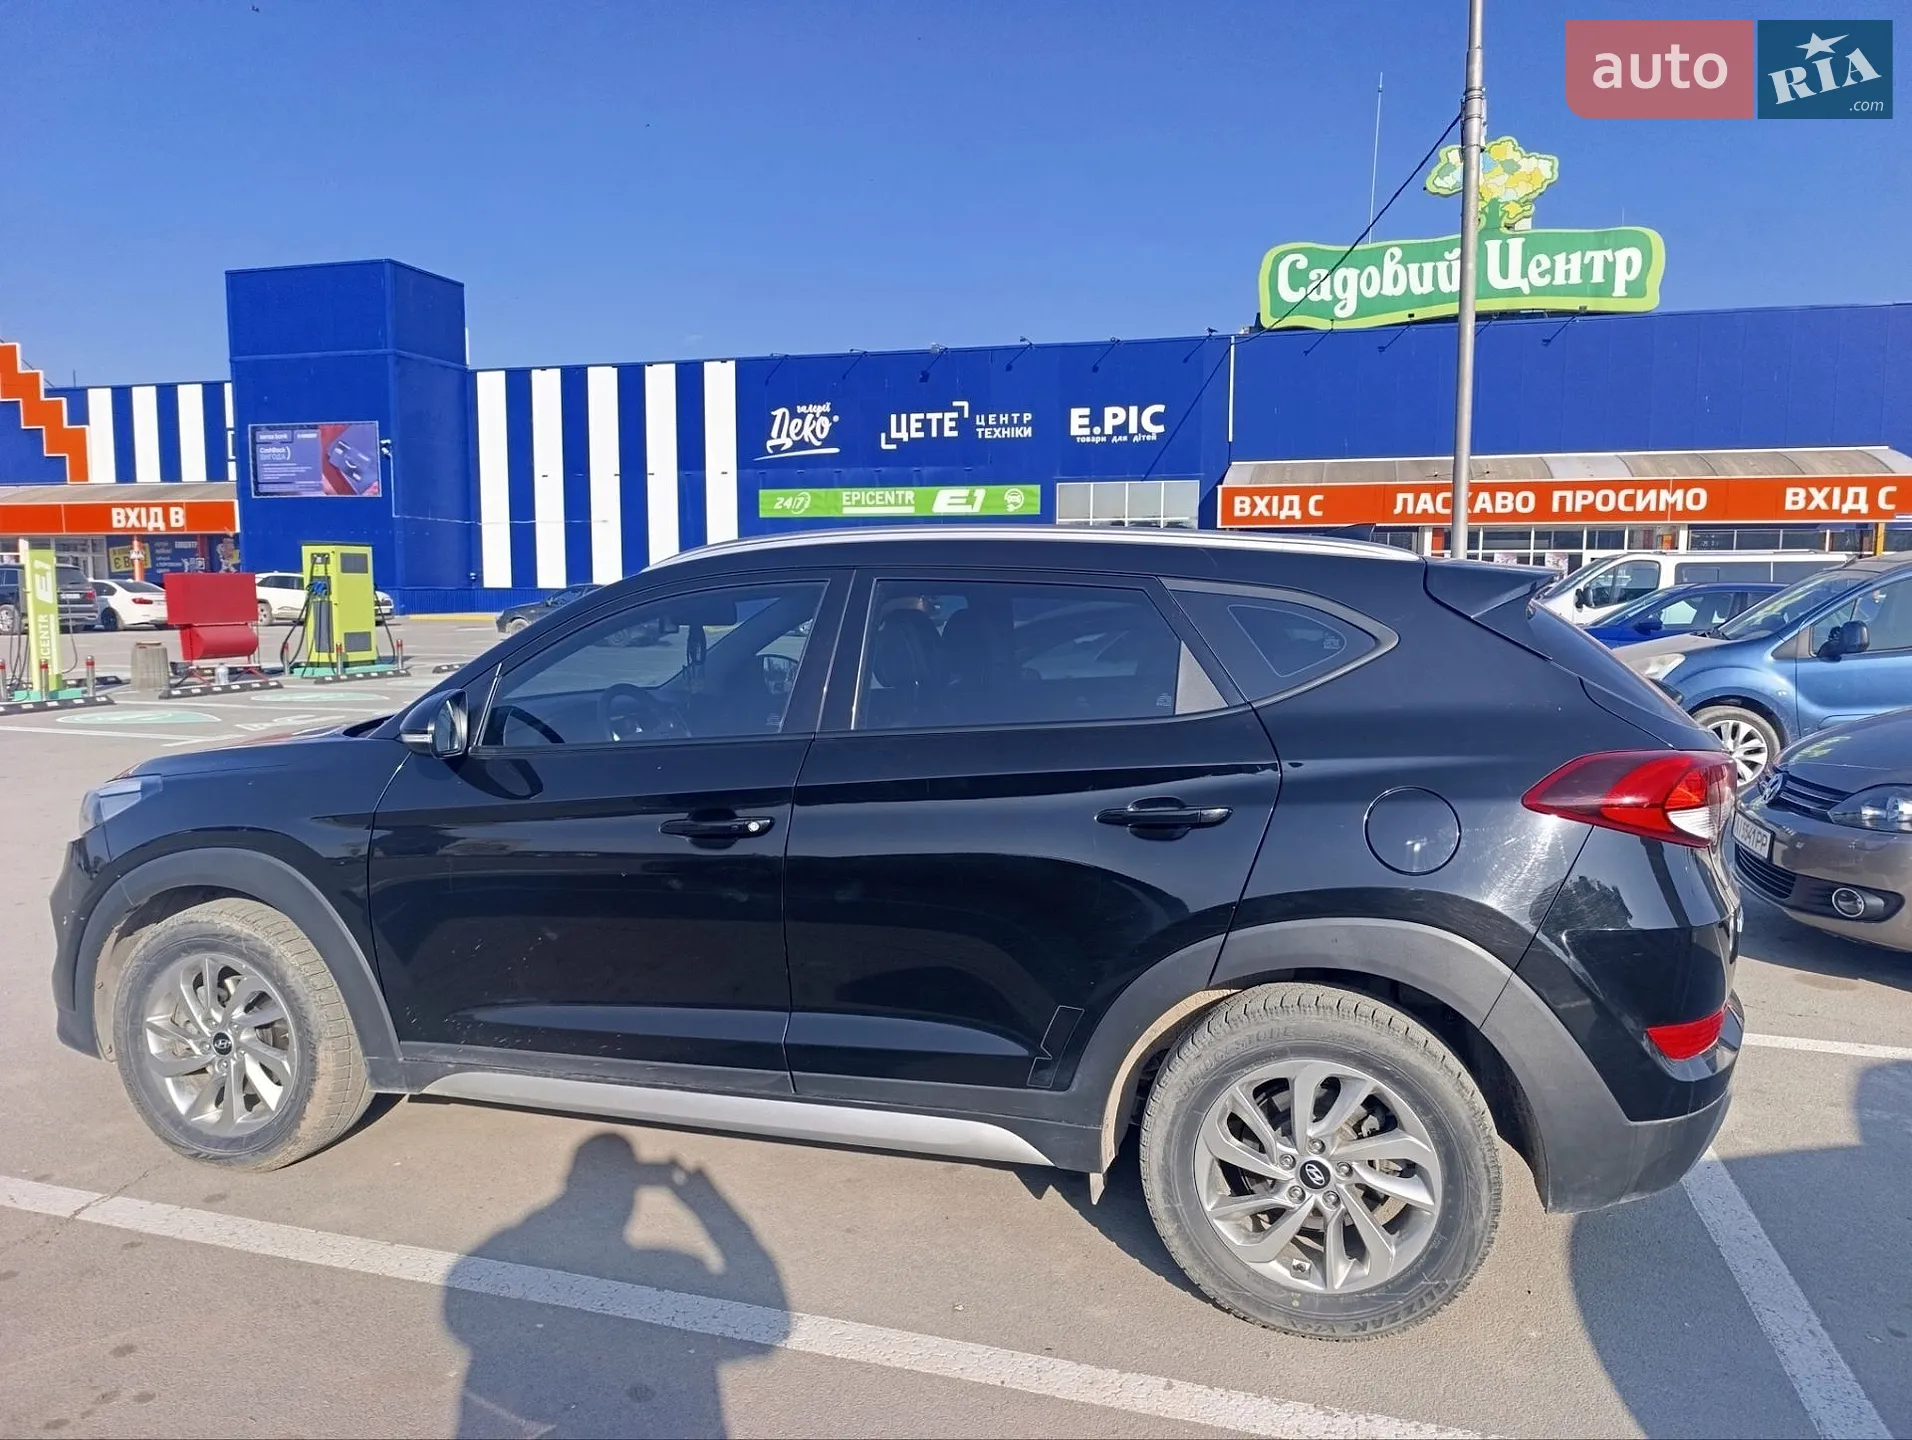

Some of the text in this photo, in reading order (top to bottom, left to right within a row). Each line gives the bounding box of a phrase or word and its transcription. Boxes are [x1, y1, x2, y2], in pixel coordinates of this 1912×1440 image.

[1277, 237, 1642, 317] Садовий Центр
[766, 407, 832, 454] Деко
[890, 412, 959, 441] ЦЕТЕ
[975, 413, 1032, 426] ЦЕНТР
[1070, 404, 1166, 435] E.PIC
[975, 427, 1032, 439] ТЕХНІКИ
[1111, 435, 1128, 443] для
[1132, 432, 1157, 443] дітей
[842, 490, 915, 505] EPICENTR
[1233, 495, 1324, 519] ВХІД С
[1393, 487, 1707, 514] ЛАСАВО ПРОСИМО
[1785, 486, 1897, 513] ВХІД С
[111, 507, 184, 531] ВХІД В
